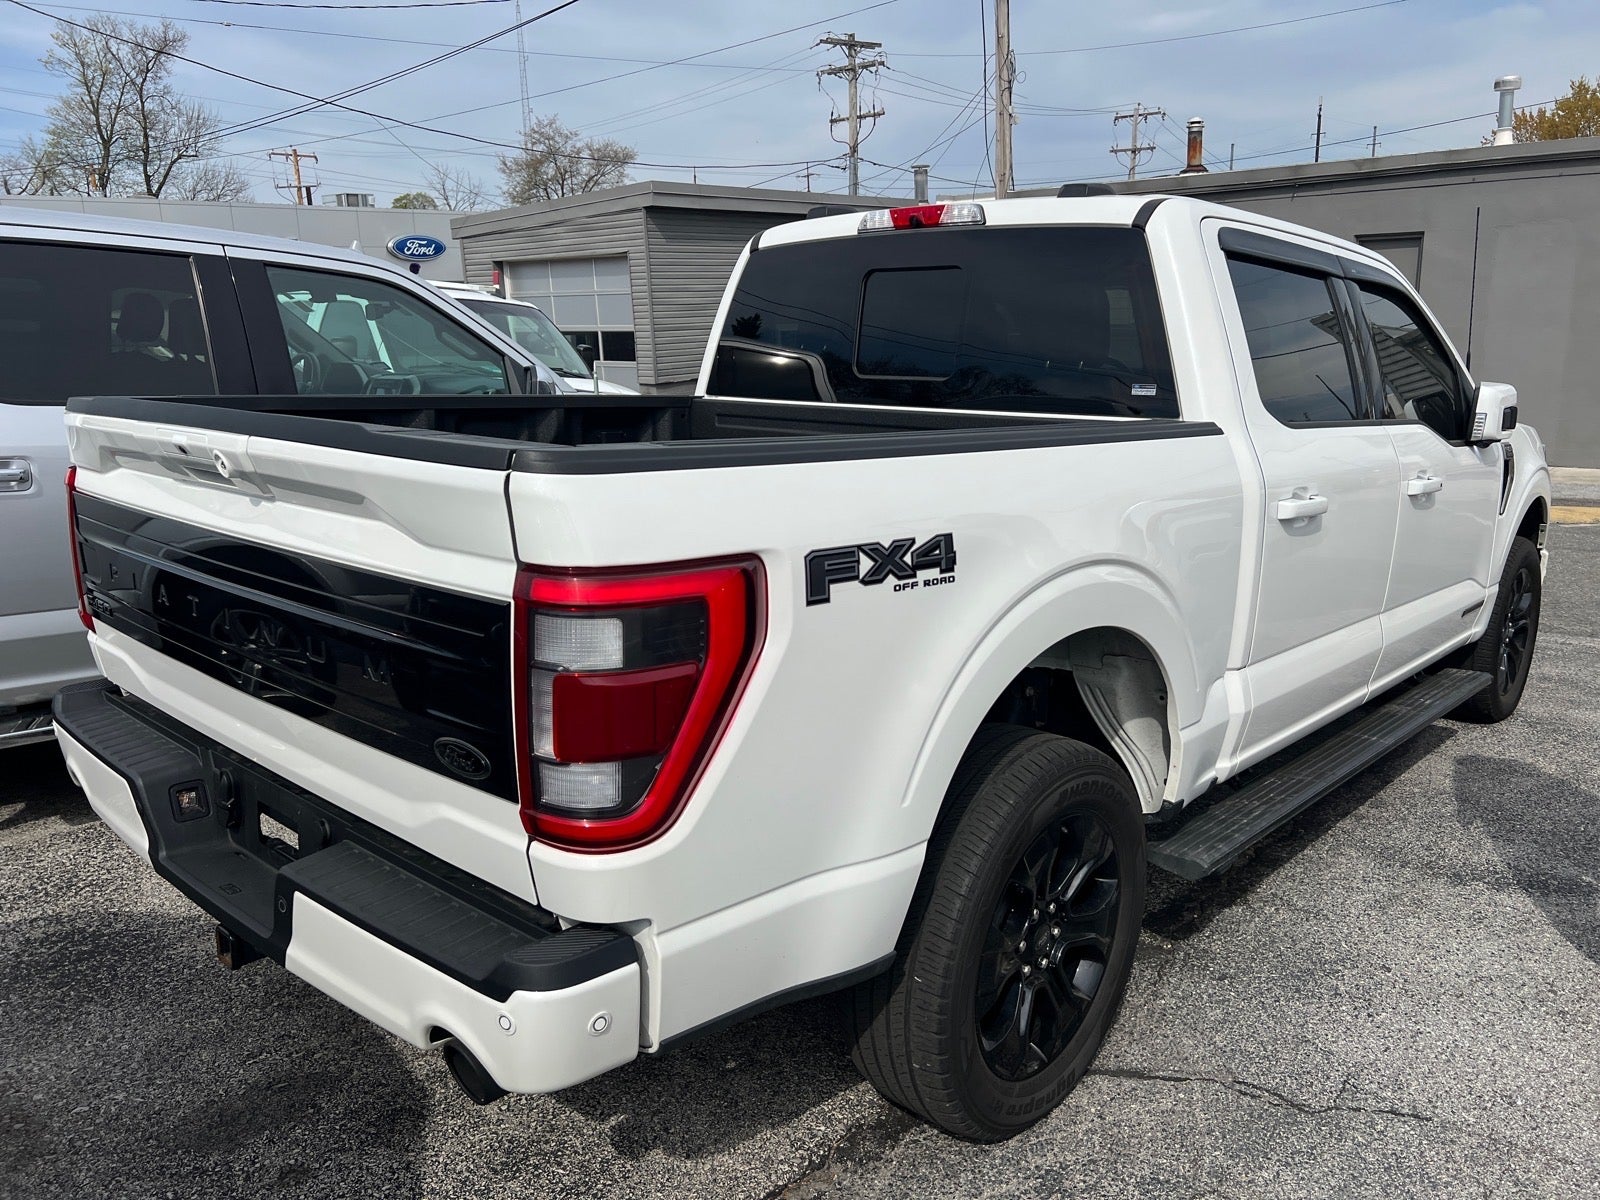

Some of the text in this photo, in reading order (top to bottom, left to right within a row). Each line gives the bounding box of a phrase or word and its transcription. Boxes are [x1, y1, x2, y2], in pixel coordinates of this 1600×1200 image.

[404, 240, 435, 255] Ford
[804, 532, 957, 607] FX4
[893, 575, 955, 592] OFF ROAD
